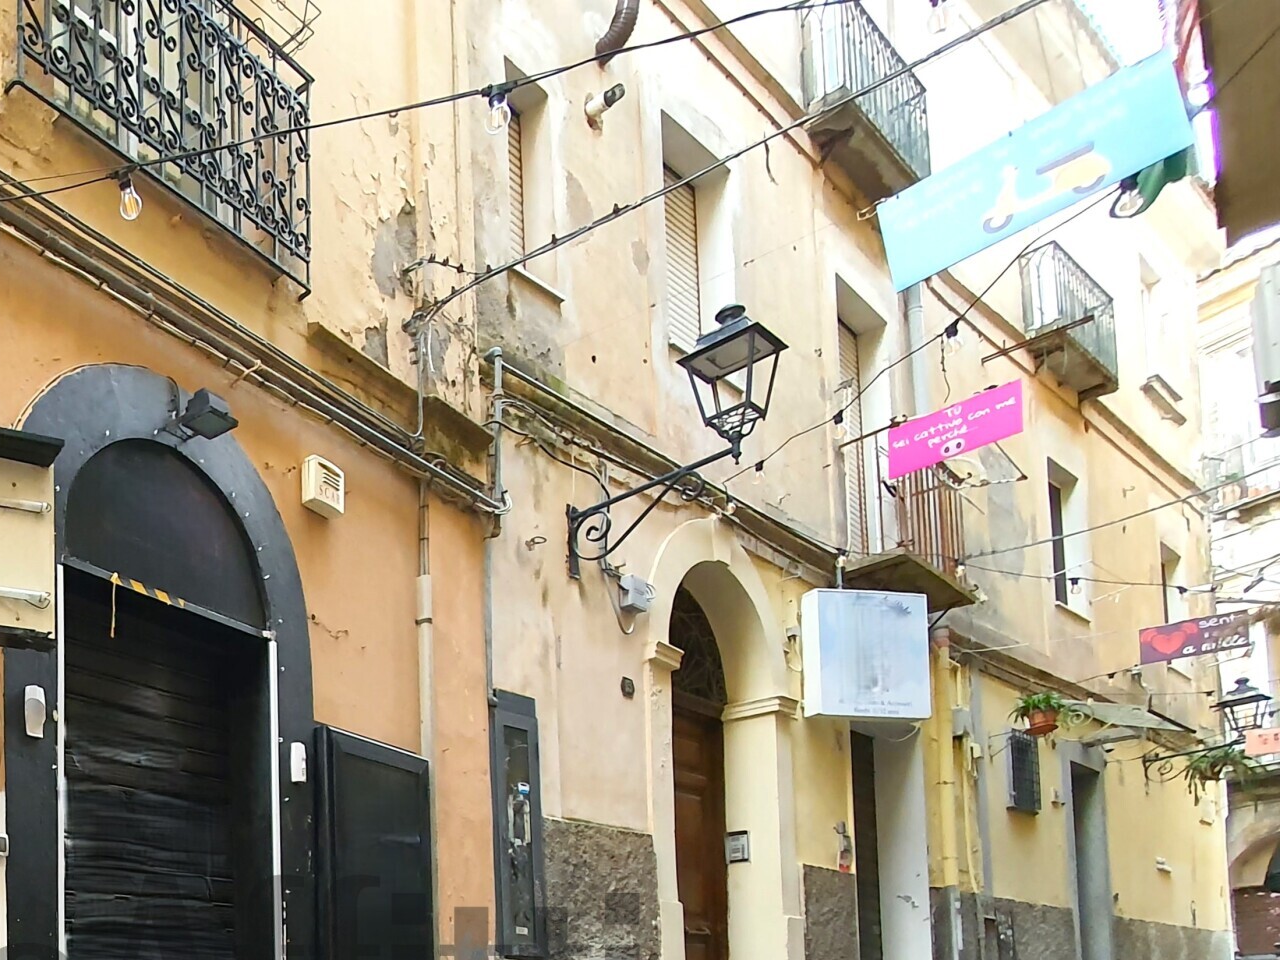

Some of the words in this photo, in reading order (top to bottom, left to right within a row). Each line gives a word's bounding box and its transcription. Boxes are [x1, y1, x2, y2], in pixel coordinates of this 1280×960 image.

[891, 439, 910, 449] sei
[913, 417, 963, 442] cattivo
[967, 408, 992, 420] con
[1182, 644, 1198, 655] a
